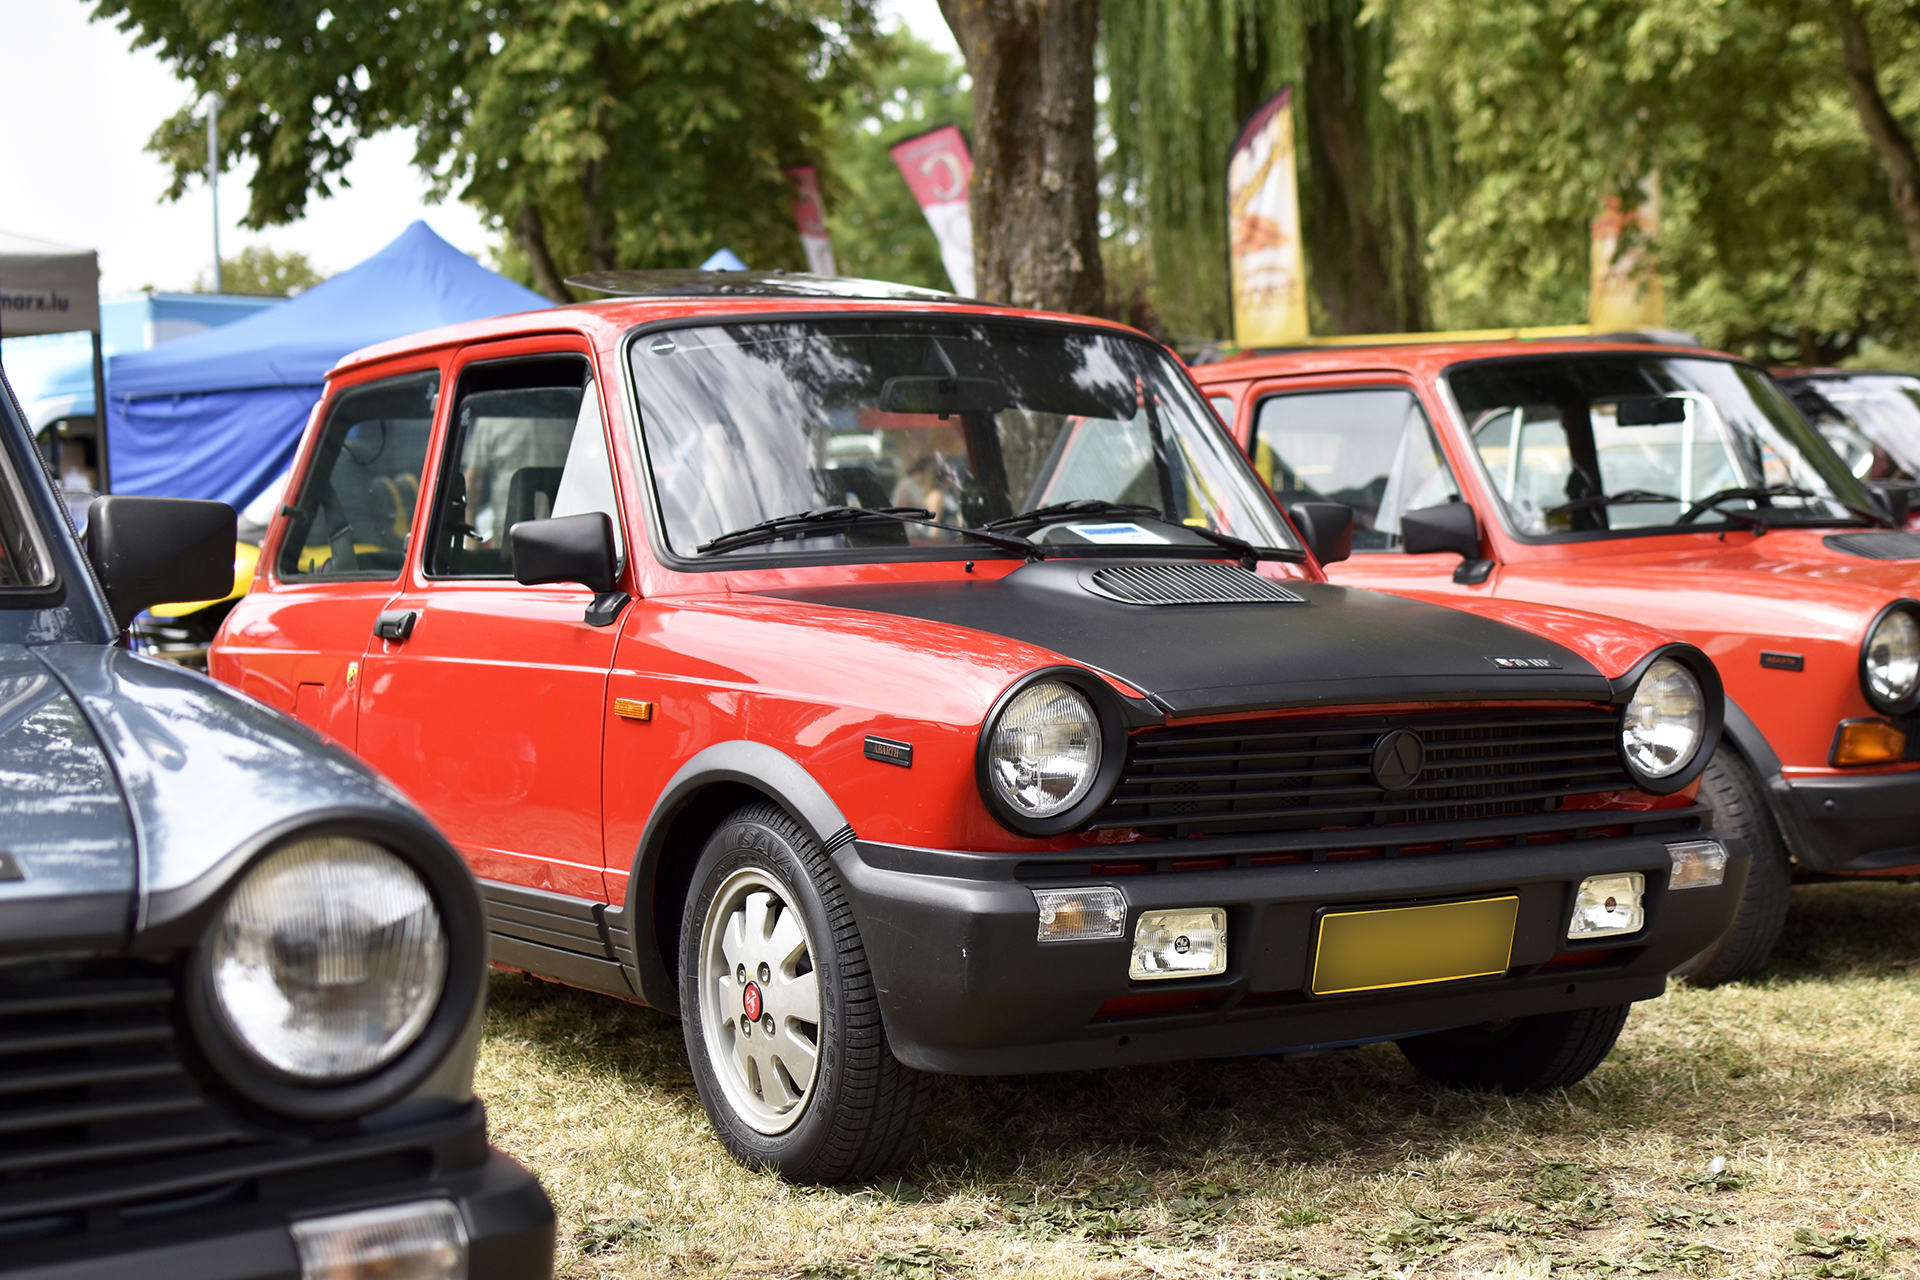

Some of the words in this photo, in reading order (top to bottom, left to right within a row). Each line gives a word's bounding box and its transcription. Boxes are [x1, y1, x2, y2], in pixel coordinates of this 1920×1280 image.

[1509, 658, 1529, 667] 70
[1526, 658, 1549, 667] HP
[873, 744, 899, 757] ABARTH
[740, 827, 797, 882] SAVA
